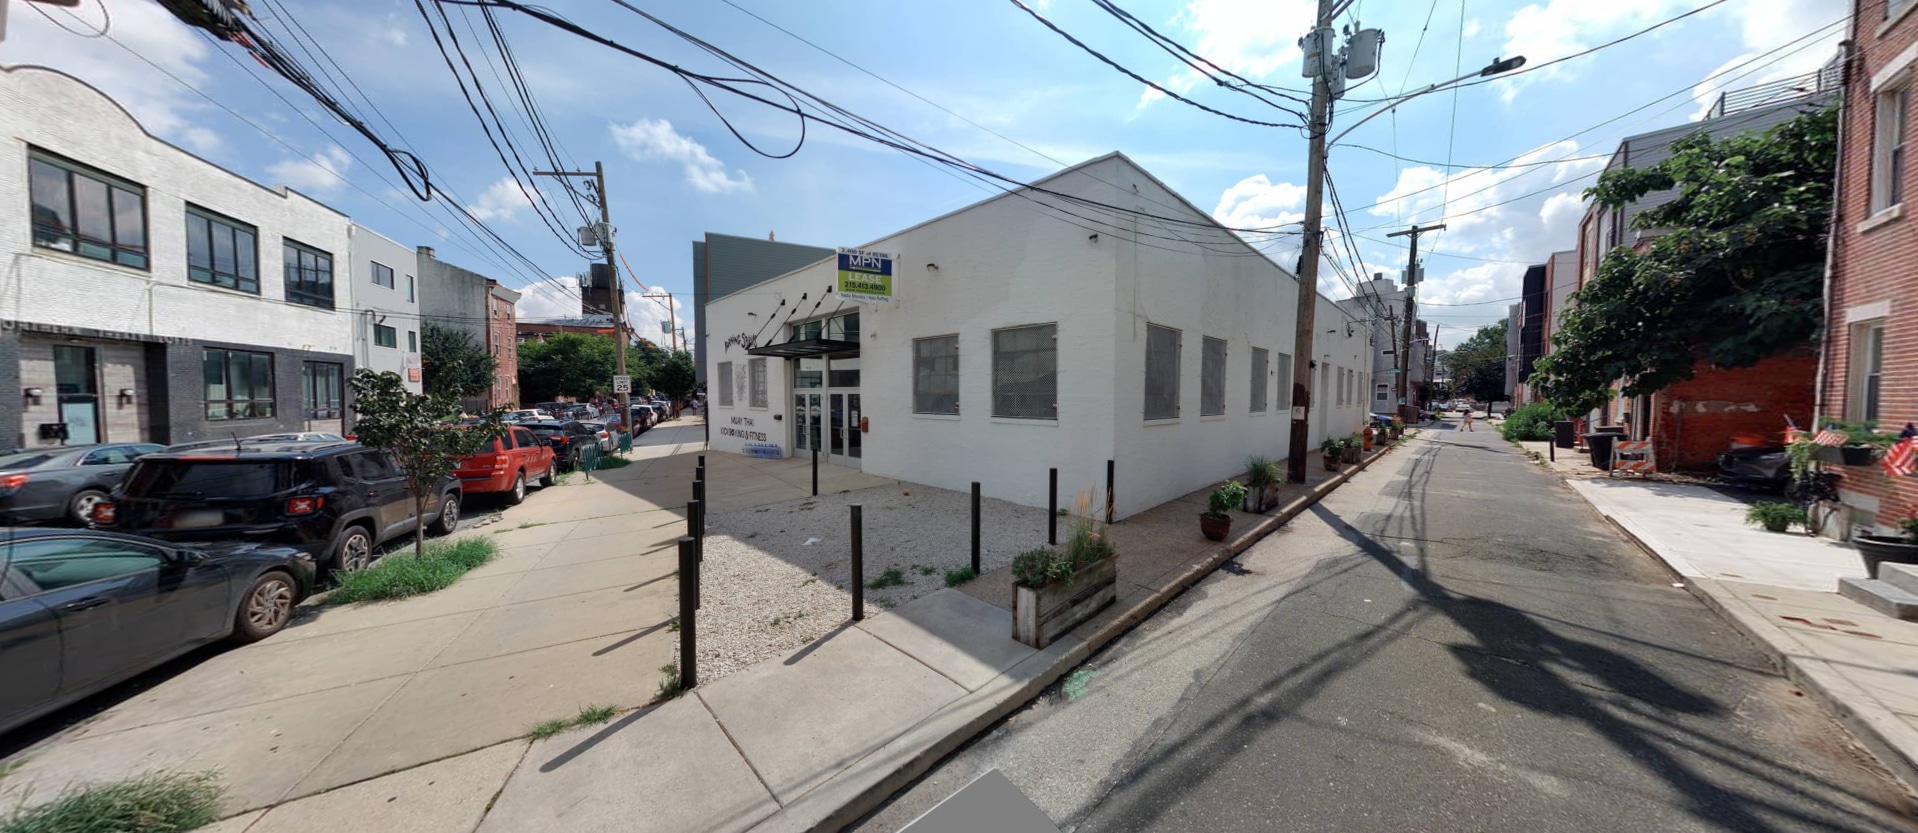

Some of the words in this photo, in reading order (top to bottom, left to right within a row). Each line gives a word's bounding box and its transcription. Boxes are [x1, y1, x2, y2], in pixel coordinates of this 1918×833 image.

[849, 255, 881, 269] MPN
[848, 272, 882, 284] LEASE
[730, 416, 743, 425] MUAY
[744, 417, 754, 426] THAI
[749, 431, 767, 442] FITNESS
